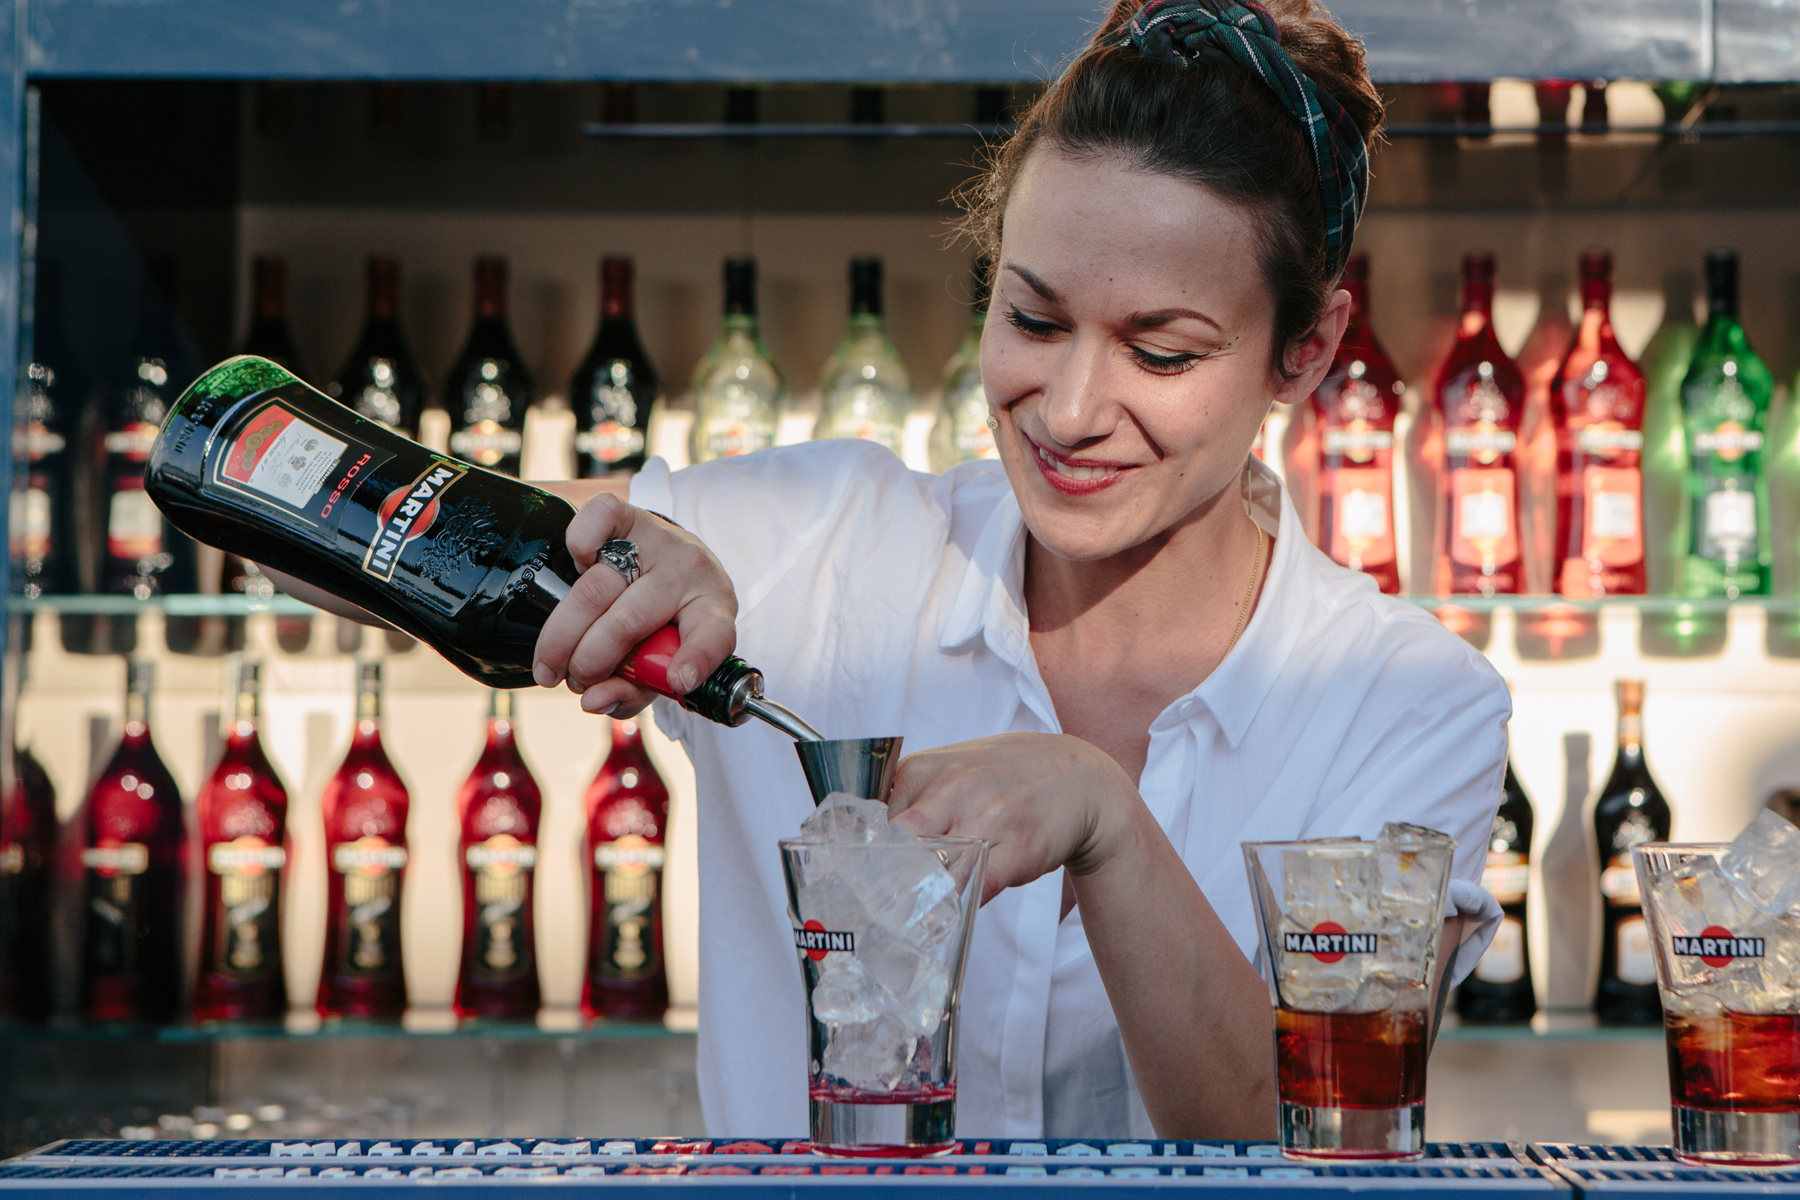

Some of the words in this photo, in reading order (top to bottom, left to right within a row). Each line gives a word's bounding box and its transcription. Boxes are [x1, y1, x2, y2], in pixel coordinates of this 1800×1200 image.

[321, 453, 372, 519] ROSSO
[372, 467, 454, 571] MARTINI
[1286, 934, 1376, 952] MARTINI
[1673, 938, 1764, 956] MARTINI
